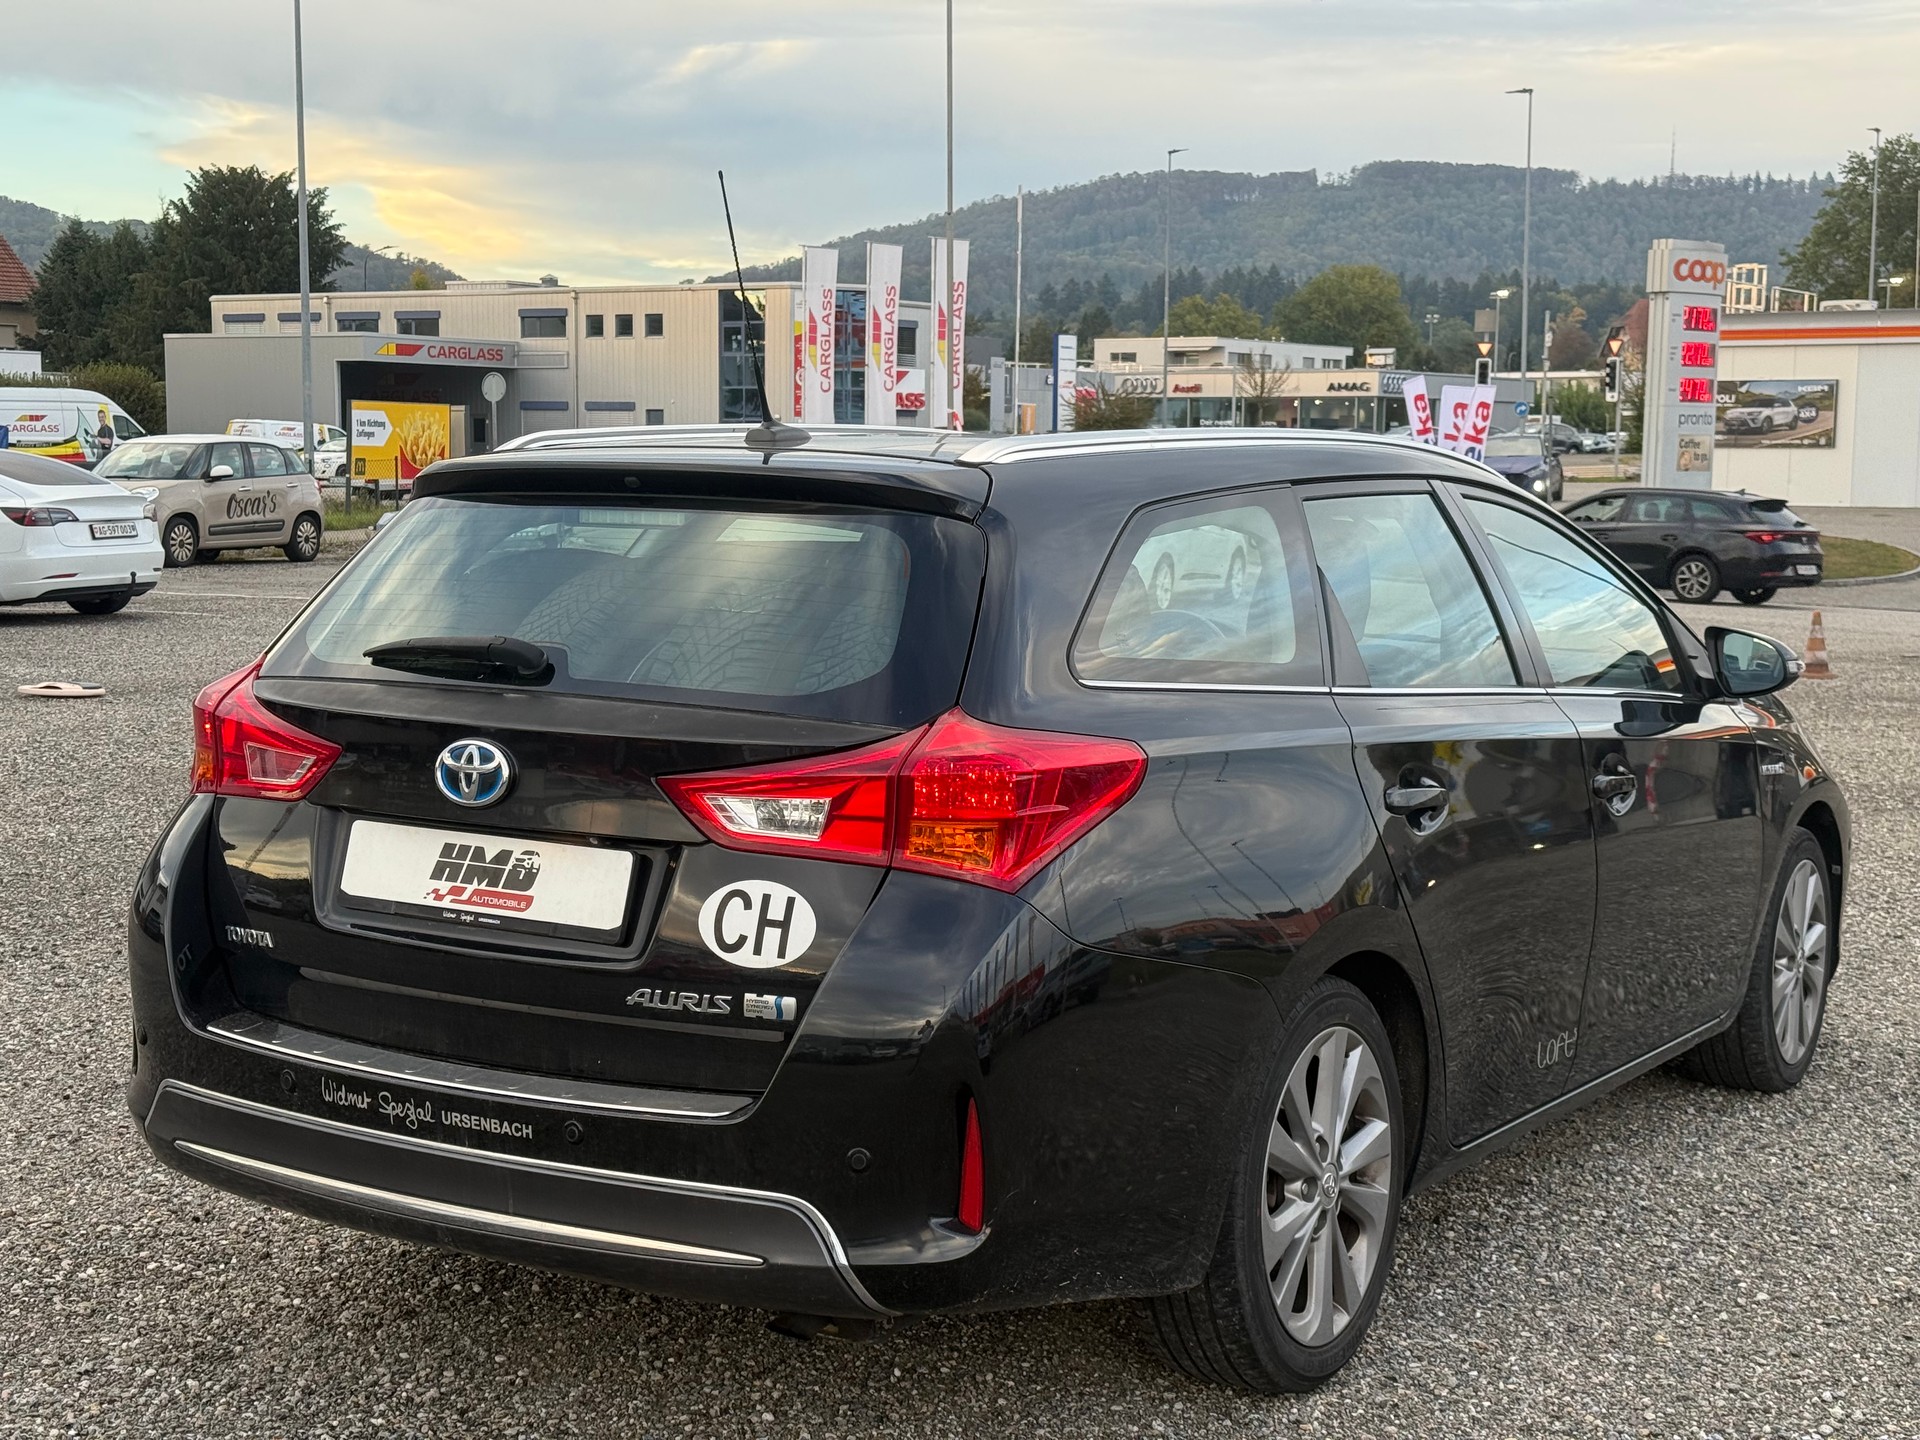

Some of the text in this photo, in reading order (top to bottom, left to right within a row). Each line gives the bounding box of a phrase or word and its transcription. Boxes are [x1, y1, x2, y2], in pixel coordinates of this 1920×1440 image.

[1673, 258, 1726, 290] coop
[820, 288, 833, 393] CARGLASS
[883, 285, 896, 392] CARGLASS
[952, 281, 965, 389] CARGLASS
[427, 345, 504, 361] CARGLASS
[1172, 383, 1203, 393] Audi
[1326, 382, 1372, 392] AMAG
[367, 419, 386, 430] Richtung
[1678, 412, 1713, 428] pronto
[226, 489, 276, 519] Oscar's
[471, 895, 527, 909] AUTOMOBILE
[225, 925, 274, 948] TOYOTA
[714, 889, 796, 960] CH
[625, 988, 732, 1015] AURIS
[441, 1110, 533, 1139] URSENBACH
